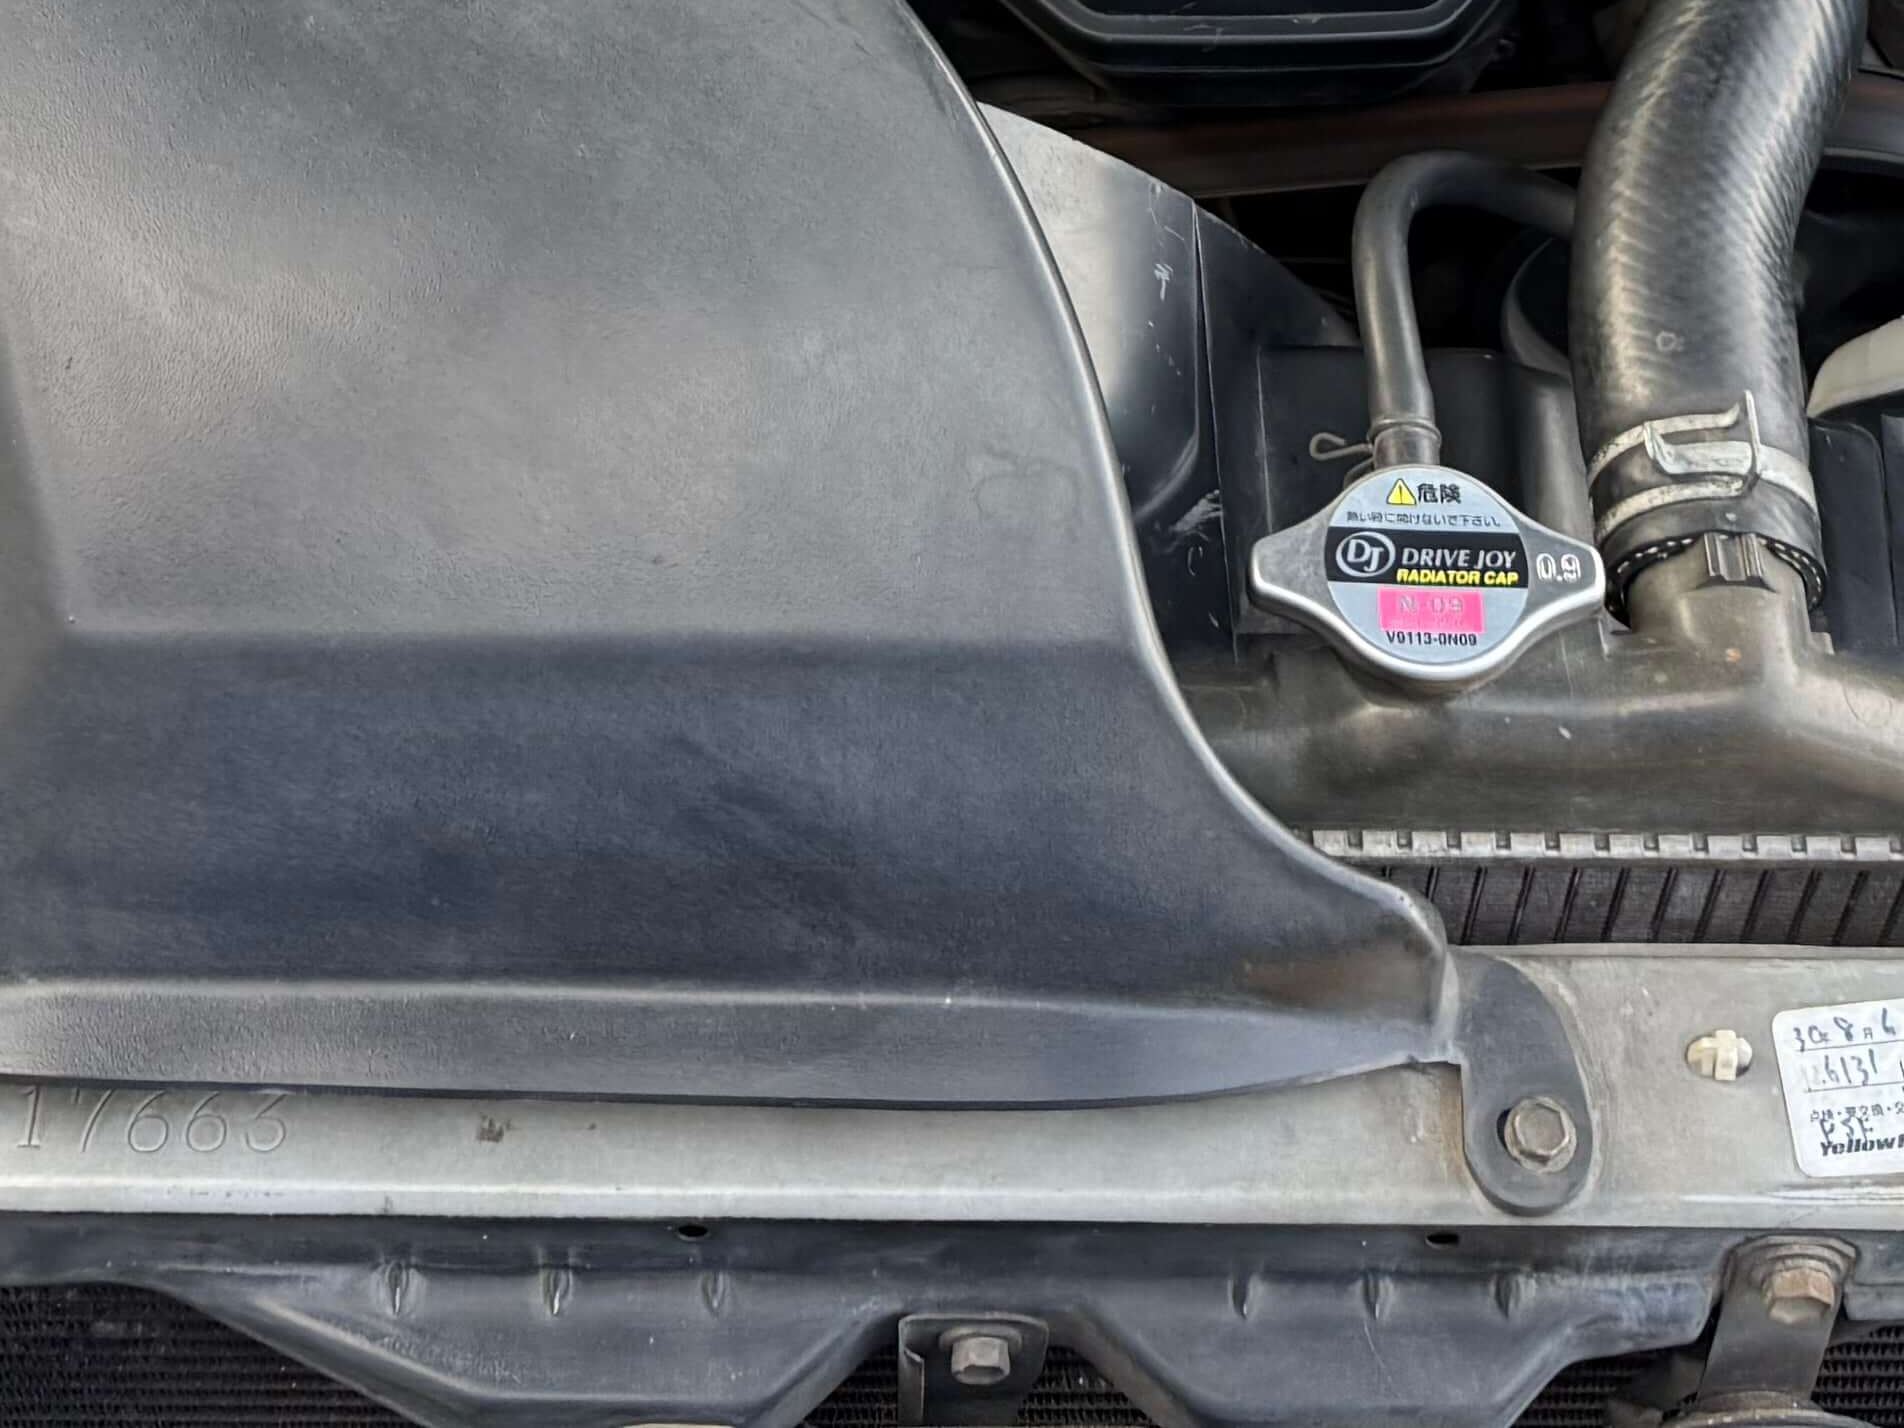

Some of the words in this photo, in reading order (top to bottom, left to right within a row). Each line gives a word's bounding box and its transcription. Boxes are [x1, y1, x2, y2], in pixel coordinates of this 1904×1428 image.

[1417, 483, 1462, 505] 危険
[1401, 547, 1470, 569] DRIVE
[1475, 549, 1517, 571] JOY
[1535, 552, 1582, 583] 0.9
[1395, 568, 1482, 585] RADIATOR
[1484, 570, 1519, 586] CAP
[15, 1084, 295, 1154] 17663
